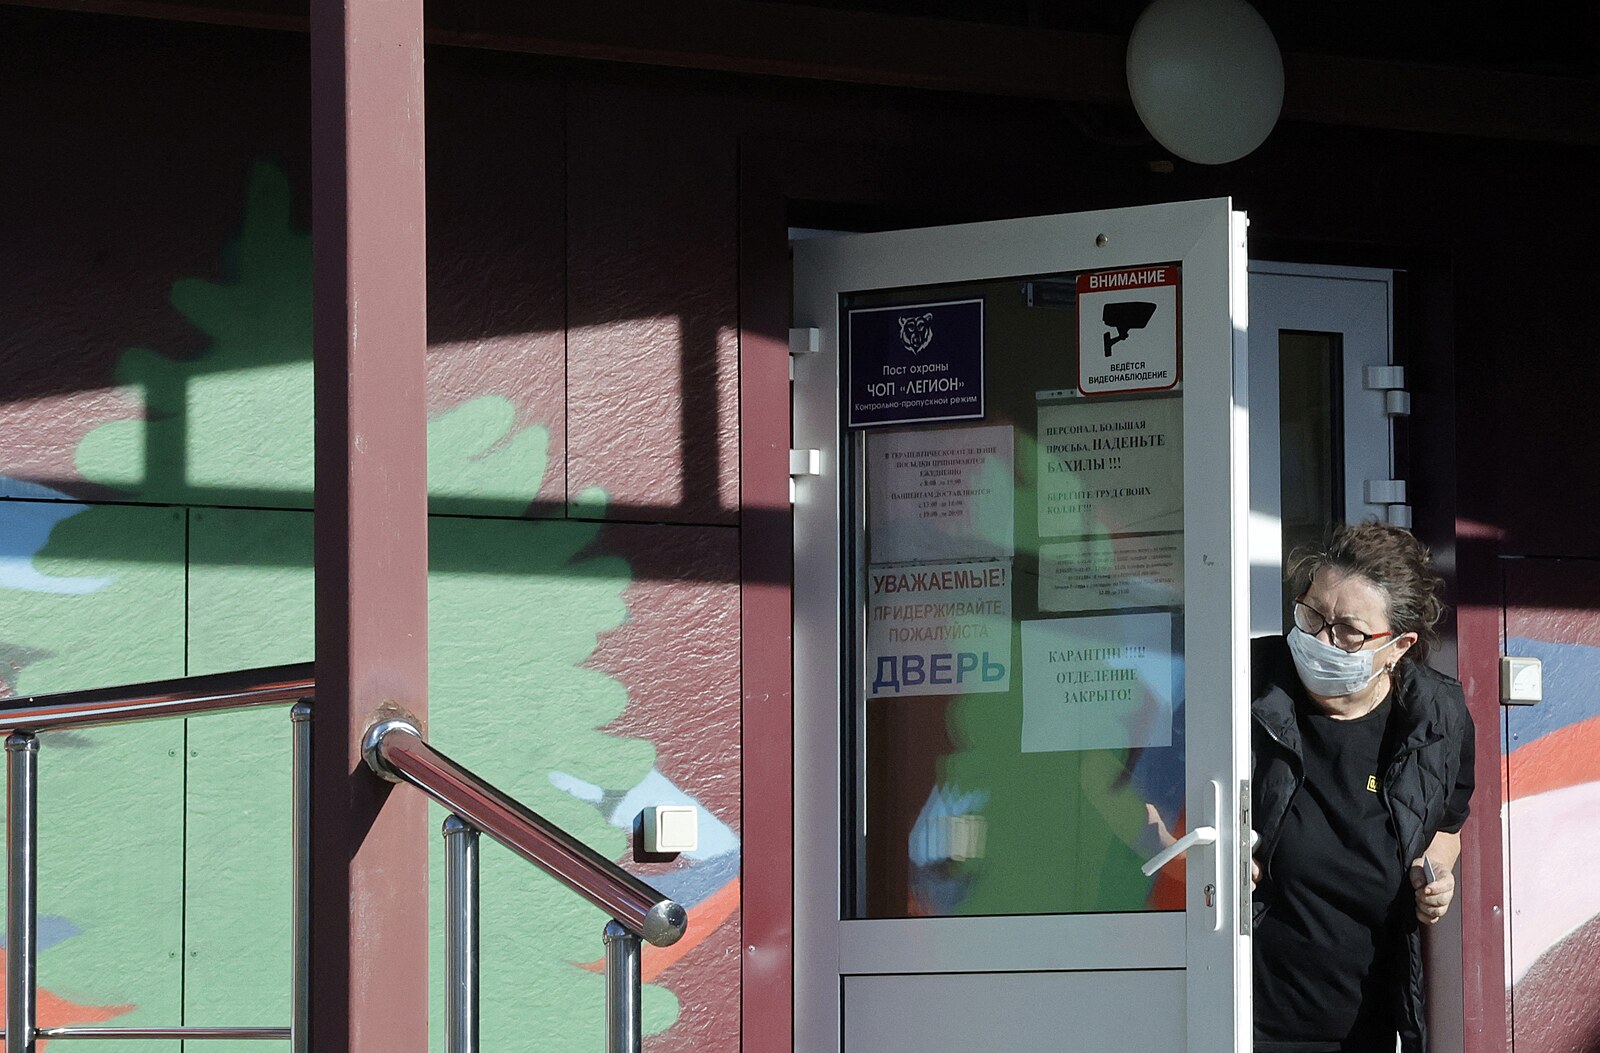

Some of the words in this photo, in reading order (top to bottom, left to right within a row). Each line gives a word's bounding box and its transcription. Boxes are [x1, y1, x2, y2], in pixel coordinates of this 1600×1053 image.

[1089, 270, 1166, 288] ВНИМАНИЕ
[883, 365, 907, 376] Пост
[909, 363, 949, 375] охраны
[1110, 361, 1146, 372] ВЕДЁТСЯ
[1088, 370, 1168, 384] ВИДЕОНАБЛЮДЕНИЕ
[867, 382, 895, 397] ЧОП
[900, 377, 965, 394] «ЛЕГИОН»
[855, 397, 948, 411] Контрольно-пропускной
[950, 395, 978, 405] режим
[1046, 424, 1098, 436] ПЕРСОНАЛ,
[1100, 420, 1146, 432] БОЛЬШАЯ
[1092, 434, 1166, 451] НАДЕНЬТЕ
[1047, 458, 1106, 473] БАХИЛЫ
[1047, 490, 1092, 502] БЕРЕГИТЕ
[1095, 488, 1119, 499] ТРУД
[1119, 486, 1151, 497] СВОИХ
[873, 568, 1006, 594] УВАЖАЕМЫЕ!
[888, 621, 989, 643] ПОЖАЛУЙСТА
[1049, 647, 1121, 664] КАРАНТИН
[872, 652, 1006, 694] ДВЕРЬ
[1056, 668, 1138, 685] ОТДЕЛЕНИЕ
[1064, 688, 1132, 704] ЗАКРЫТО!
